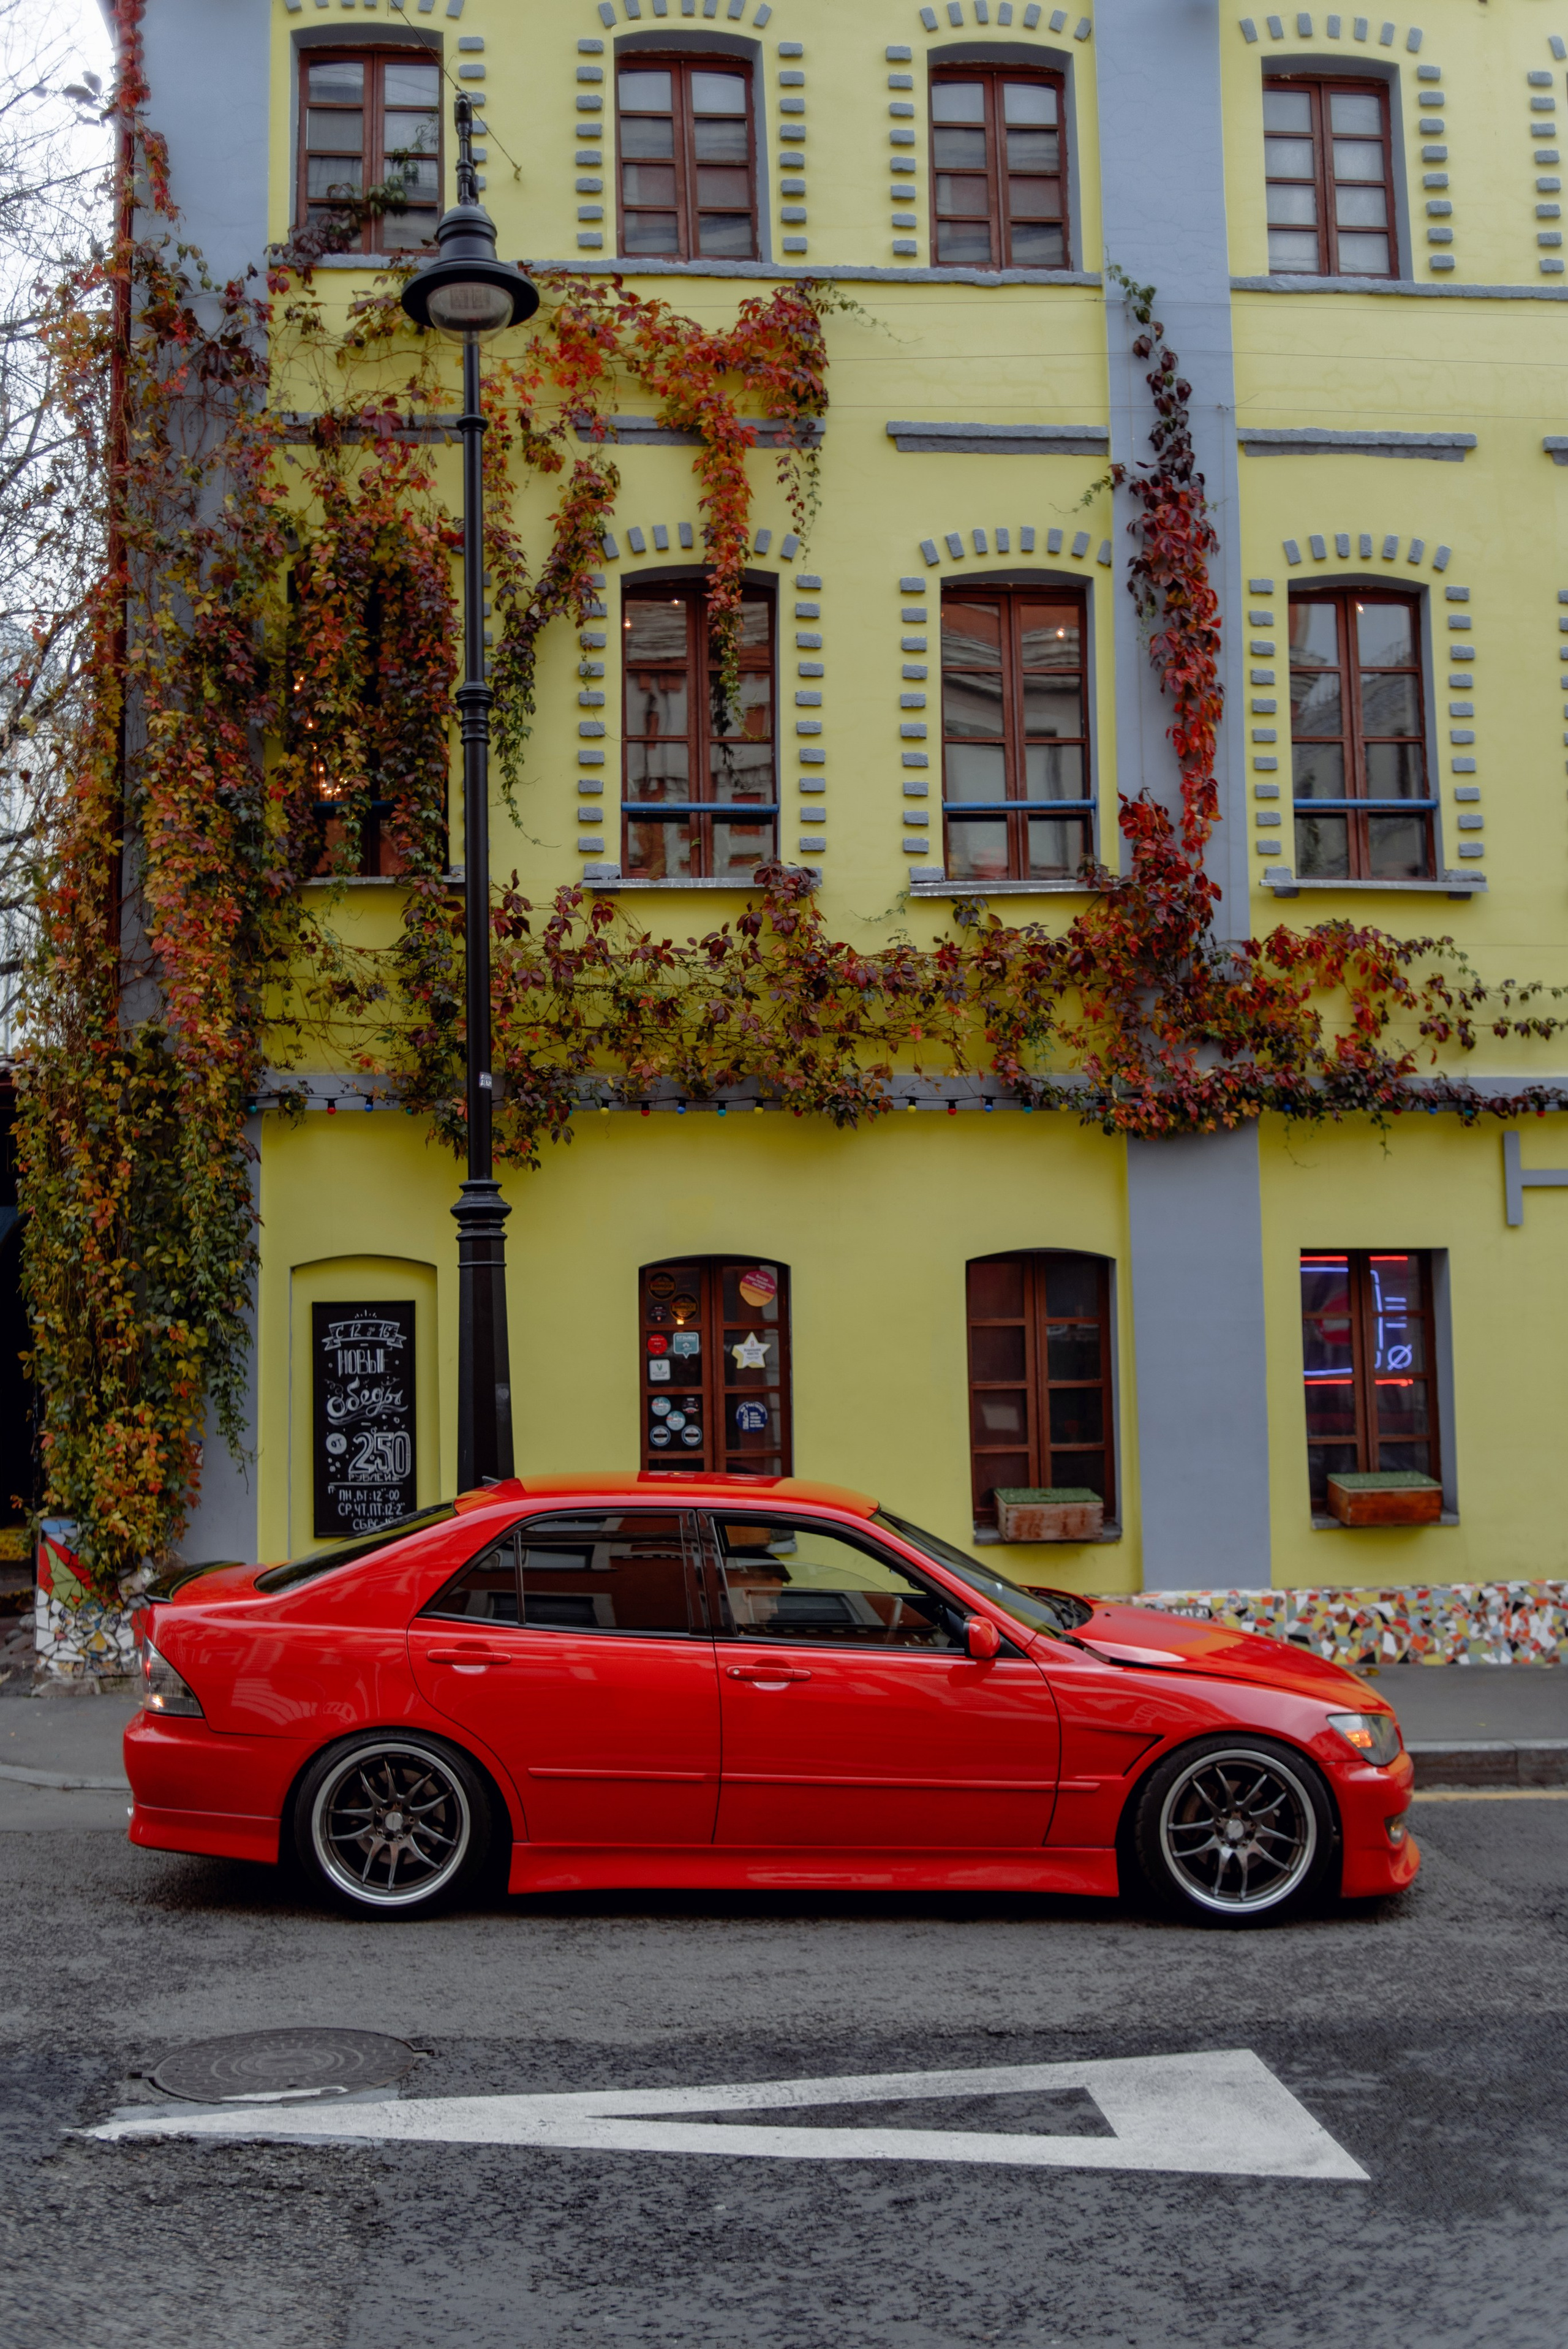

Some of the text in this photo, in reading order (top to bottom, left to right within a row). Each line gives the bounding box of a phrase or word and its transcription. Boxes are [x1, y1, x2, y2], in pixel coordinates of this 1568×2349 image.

[349, 1323, 361, 1338] 12
[379, 1323, 393, 1338] 16
[337, 1348, 393, 1377] НОВЫЕ
[348, 1430, 412, 1479] 250
